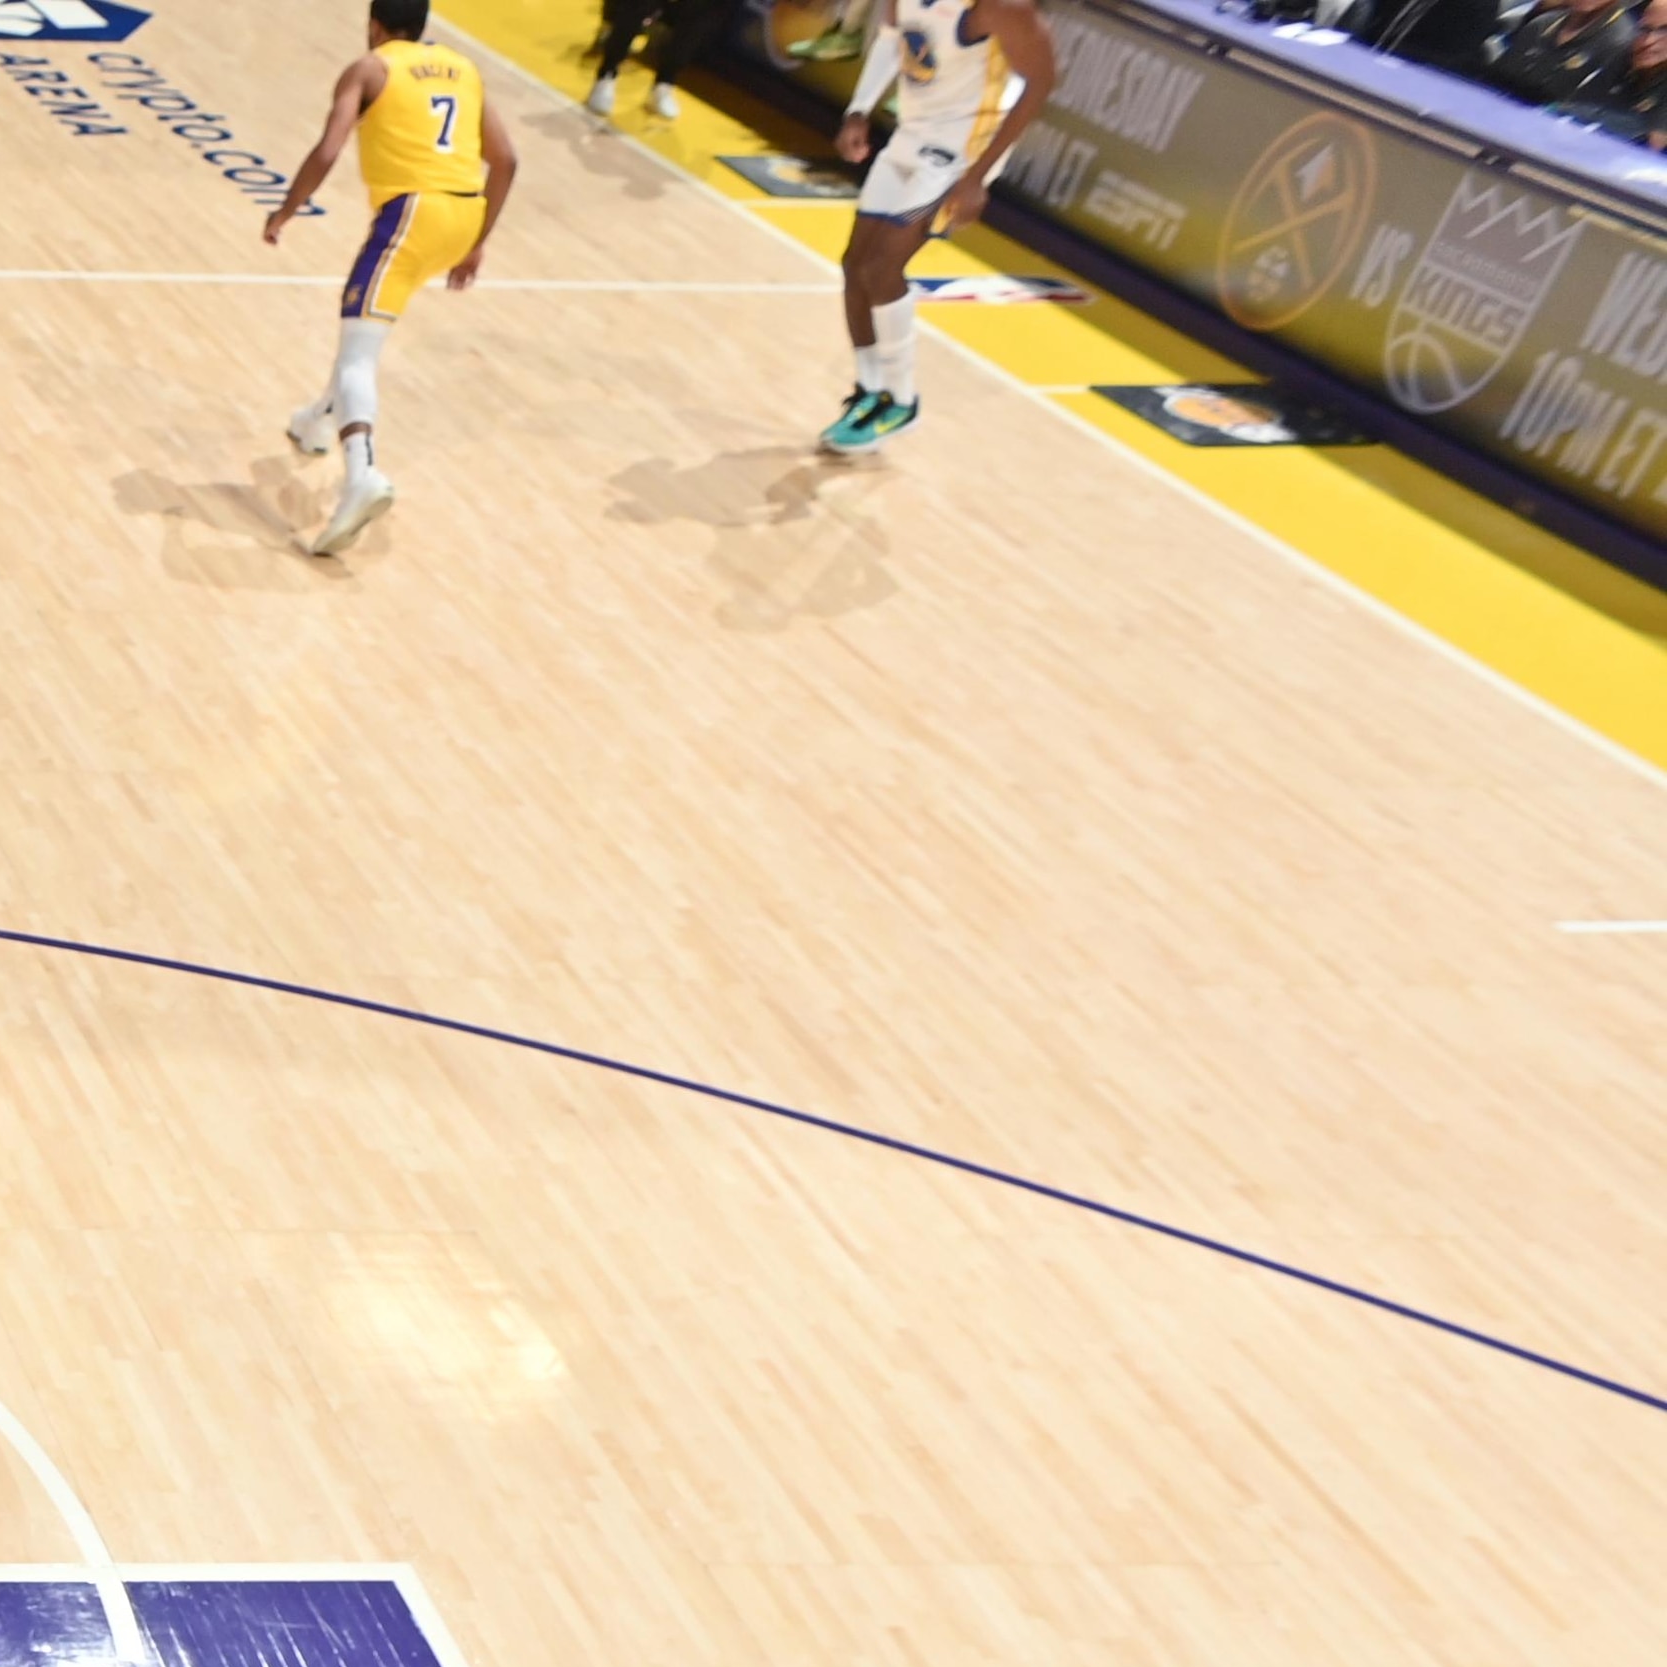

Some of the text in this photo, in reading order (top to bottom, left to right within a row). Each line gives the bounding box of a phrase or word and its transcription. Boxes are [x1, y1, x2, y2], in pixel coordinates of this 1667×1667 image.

[429, 95, 457, 154] 7
[1042, 12, 1205, 154] EDNESDAY
[1078, 169, 1190, 252] ESPN
[1350, 224, 1415, 309] VS
[1404, 265, 1529, 347] KINGS
[1500, 350, 1667, 498] 10PM ET
